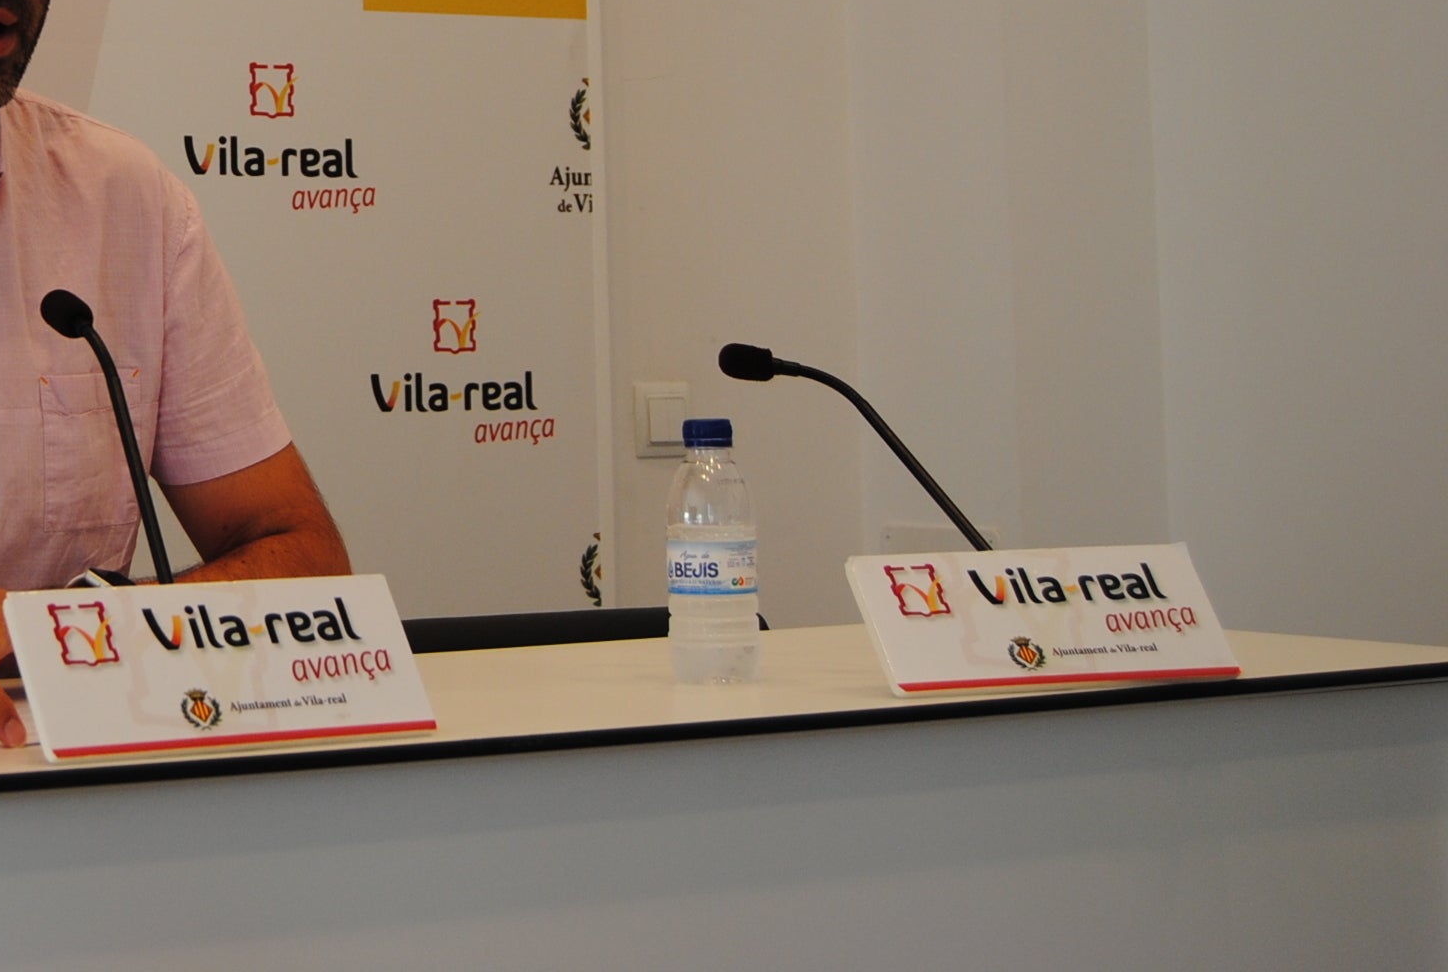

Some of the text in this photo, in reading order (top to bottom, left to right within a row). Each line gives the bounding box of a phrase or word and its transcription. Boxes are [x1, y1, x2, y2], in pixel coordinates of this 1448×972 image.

[183, 135, 358, 179] Vila-real
[291, 186, 376, 215] avança
[557, 198, 573, 213] de
[370, 370, 538, 413] Vila-real
[474, 418, 555, 446] avança
[967, 563, 1166, 605] Vila-real
[142, 597, 361, 652] Vila-real
[1105, 606, 1197, 633] avança
[291, 648, 392, 681] avança
[1053, 647, 1108, 658] Ajuntament
[1116, 642, 1158, 653] Vila-real
[230, 698, 292, 714] Ajuntament
[301, 692, 348, 707] Vila-real
